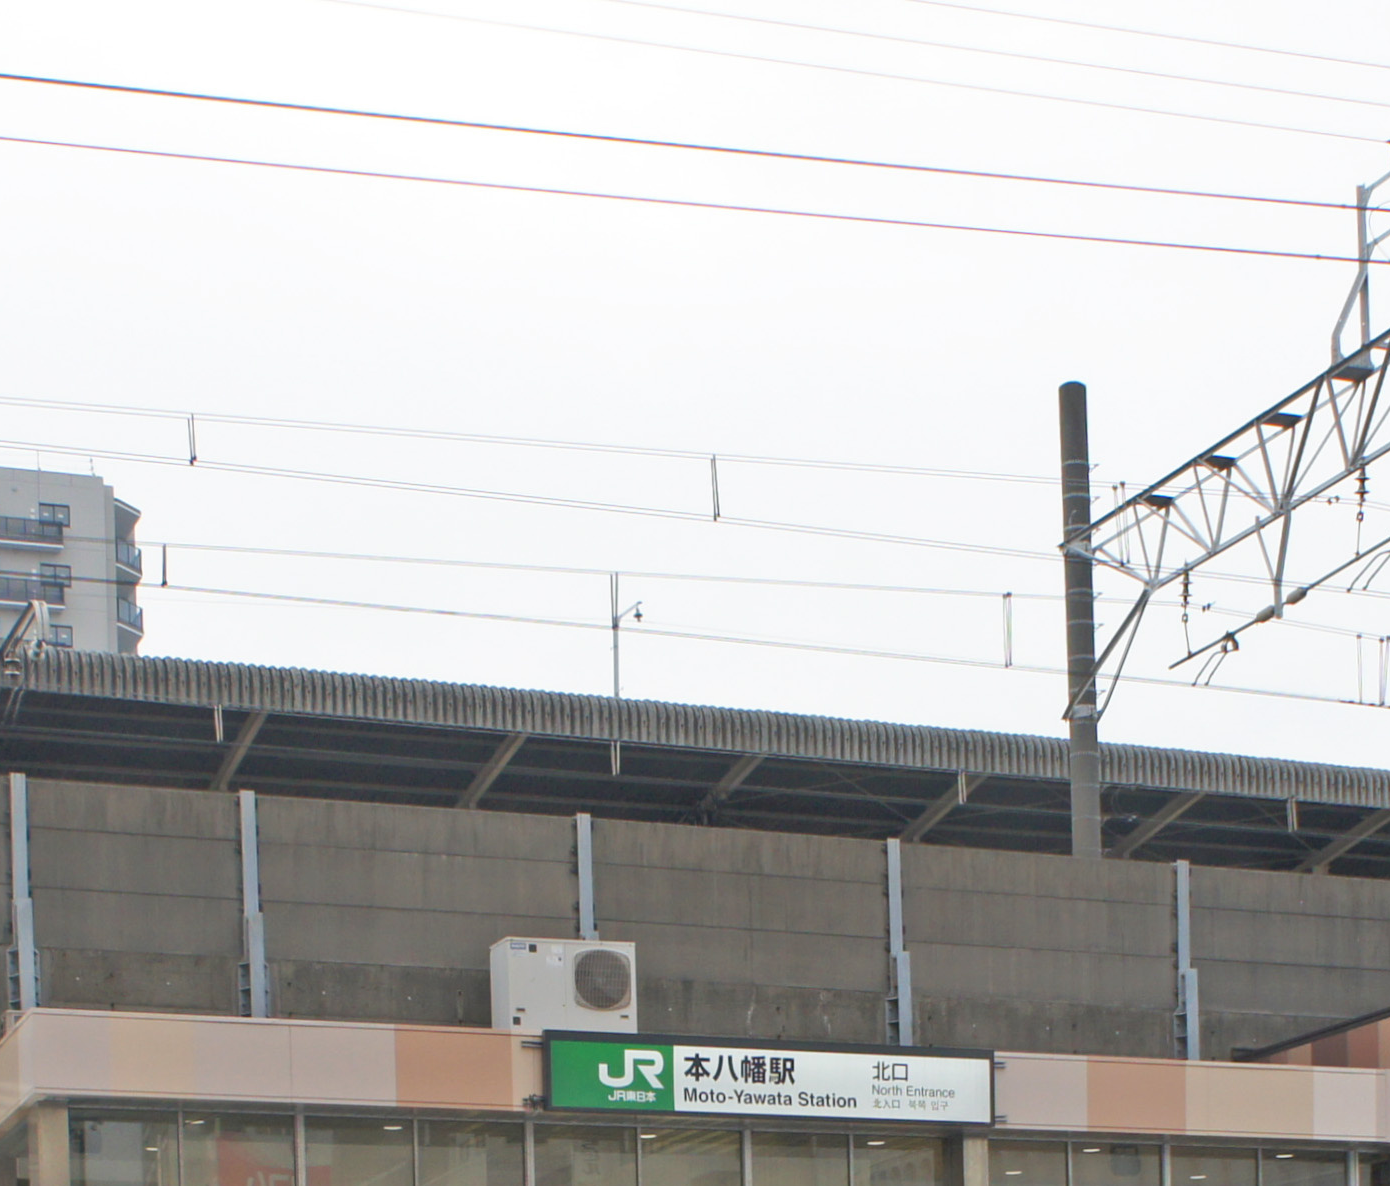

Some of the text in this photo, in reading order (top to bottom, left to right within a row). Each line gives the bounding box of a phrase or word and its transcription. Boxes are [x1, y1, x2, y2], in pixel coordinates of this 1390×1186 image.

[598, 1049, 665, 1089] JR
[683, 1053, 796, 1086] 本八幡駅
[872, 1060, 909, 1082] 北口
[608, 1089, 657, 1103] JR東日本
[683, 1087, 857, 1109] Moto-Yawata Station
[871, 1084, 955, 1099] North Entrance
